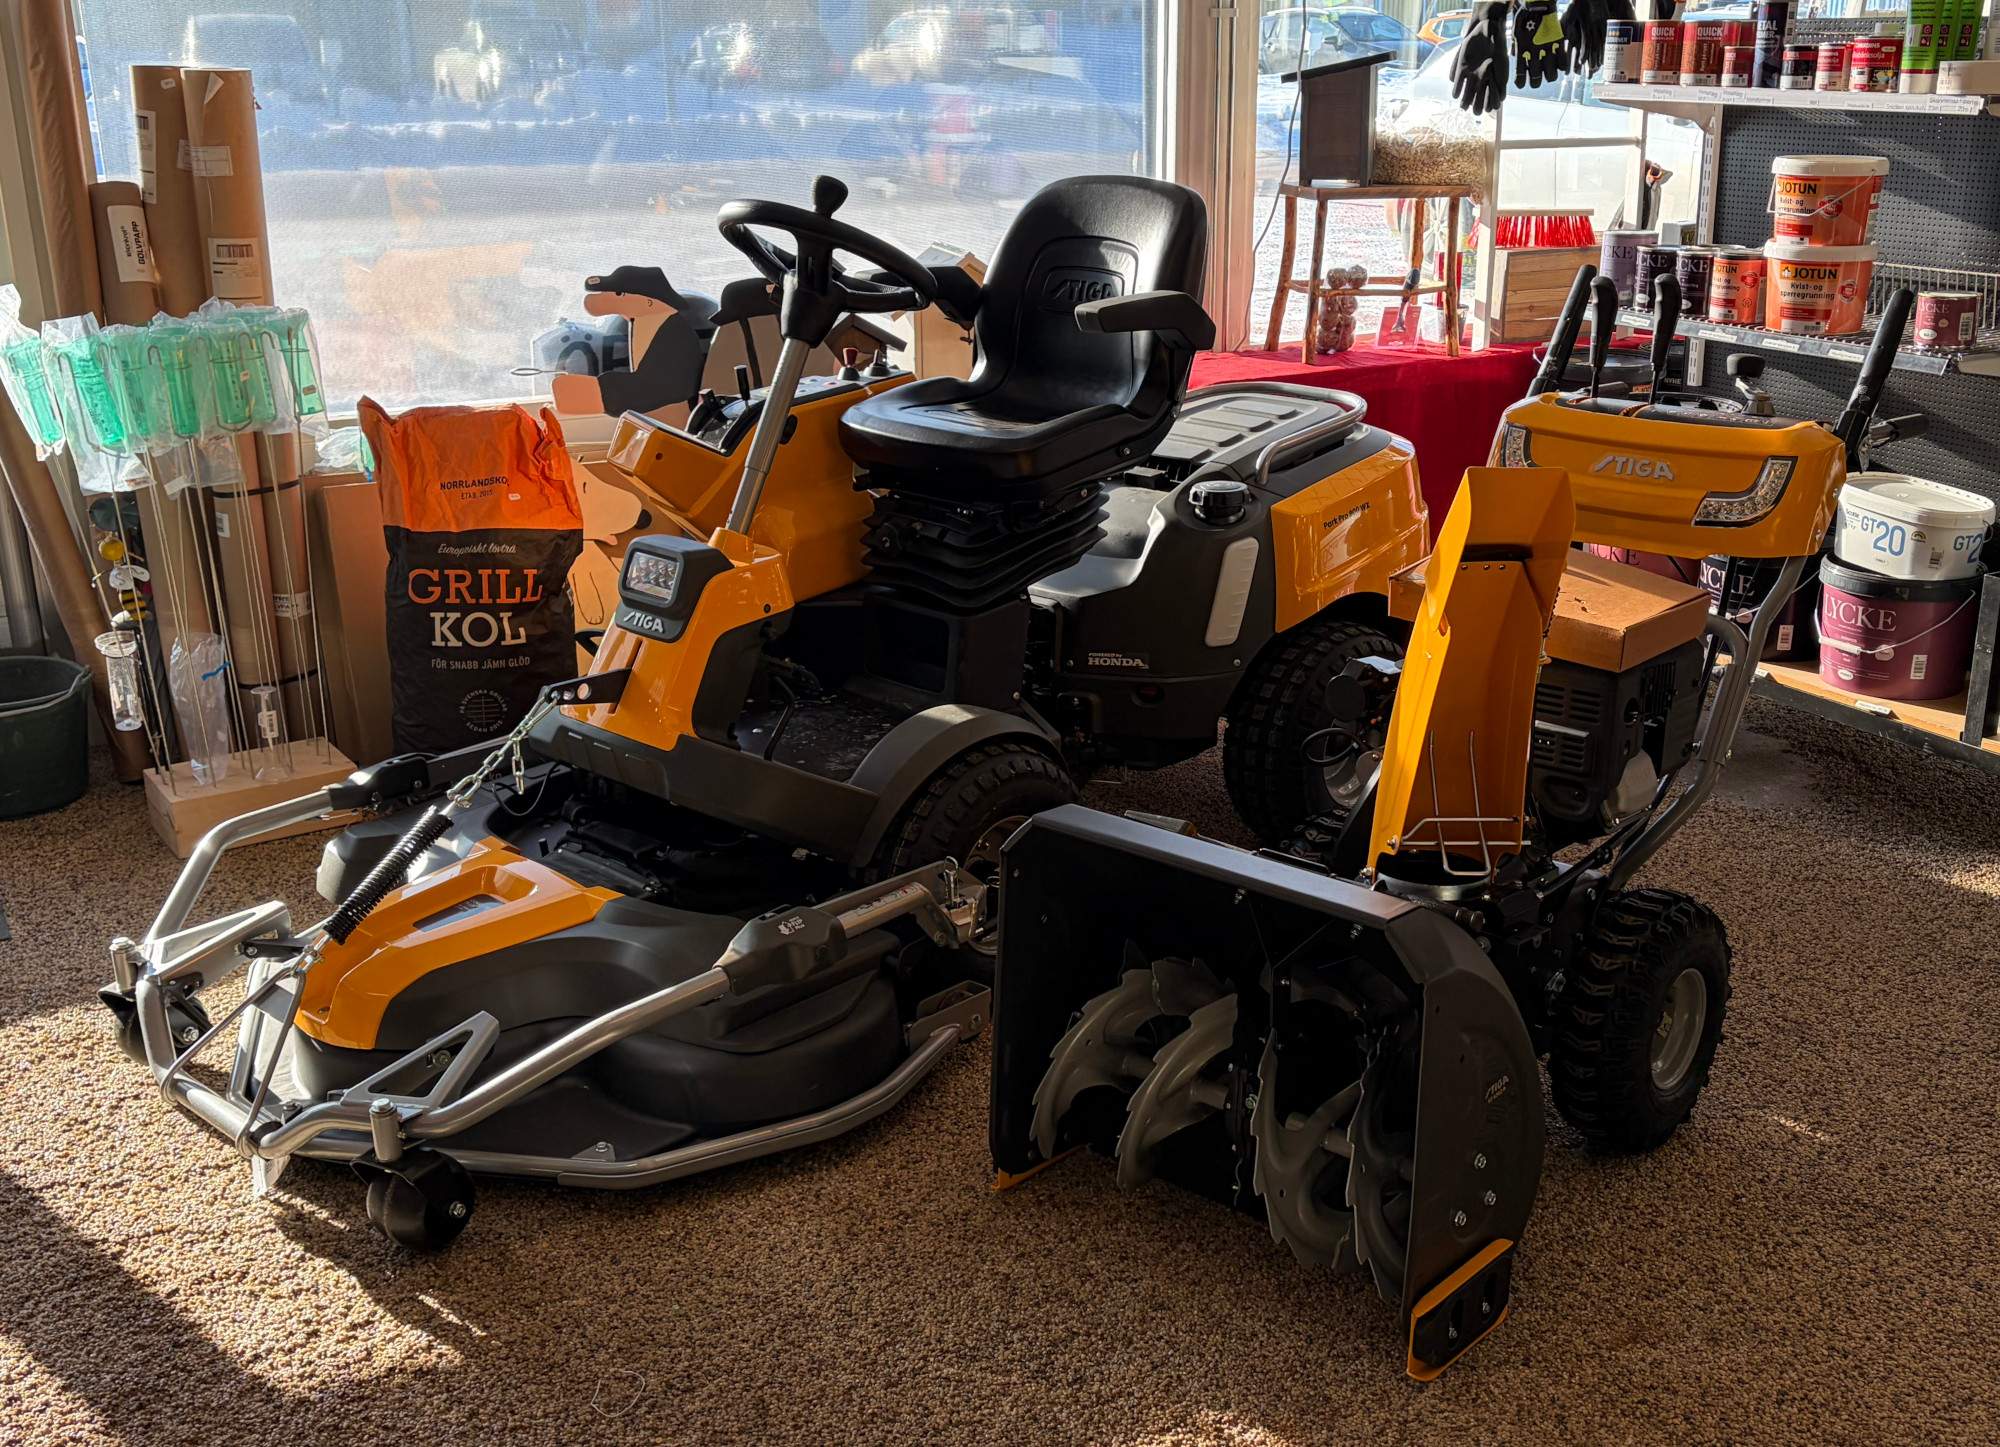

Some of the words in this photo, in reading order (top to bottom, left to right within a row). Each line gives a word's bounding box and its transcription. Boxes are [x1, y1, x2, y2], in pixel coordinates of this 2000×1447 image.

[1651, 27, 1675, 37] QUICK
[1697, 27, 1722, 37] QUICK
[1780, 182, 1817, 194] JOTUN
[132, 221, 146, 265] GOLVPAPP
[1794, 268, 1838, 280] JOTUN
[1780, 289, 1835, 301] sperregrunning
[1595, 456, 1675, 481] STIGA
[440, 476, 510, 490] NORRLANDSKO
[1323, 518, 1338, 528] Park
[1338, 513, 1349, 522] Pro
[1861, 515, 1907, 557] GT20
[438, 543, 487, 557] Europeiskt
[408, 568, 543, 604] GRILL
[1824, 592, 1897, 632] LYCKE
[623, 611, 664, 633] STIGA
[430, 612, 527, 647] KOL
[431, 657, 447, 669] FÖR
[449, 660, 479, 670] SNABB
[481, 656, 506, 670] JÄMN
[508, 656, 530, 668] GLÖD
[1088, 657, 1145, 668] HONDA
